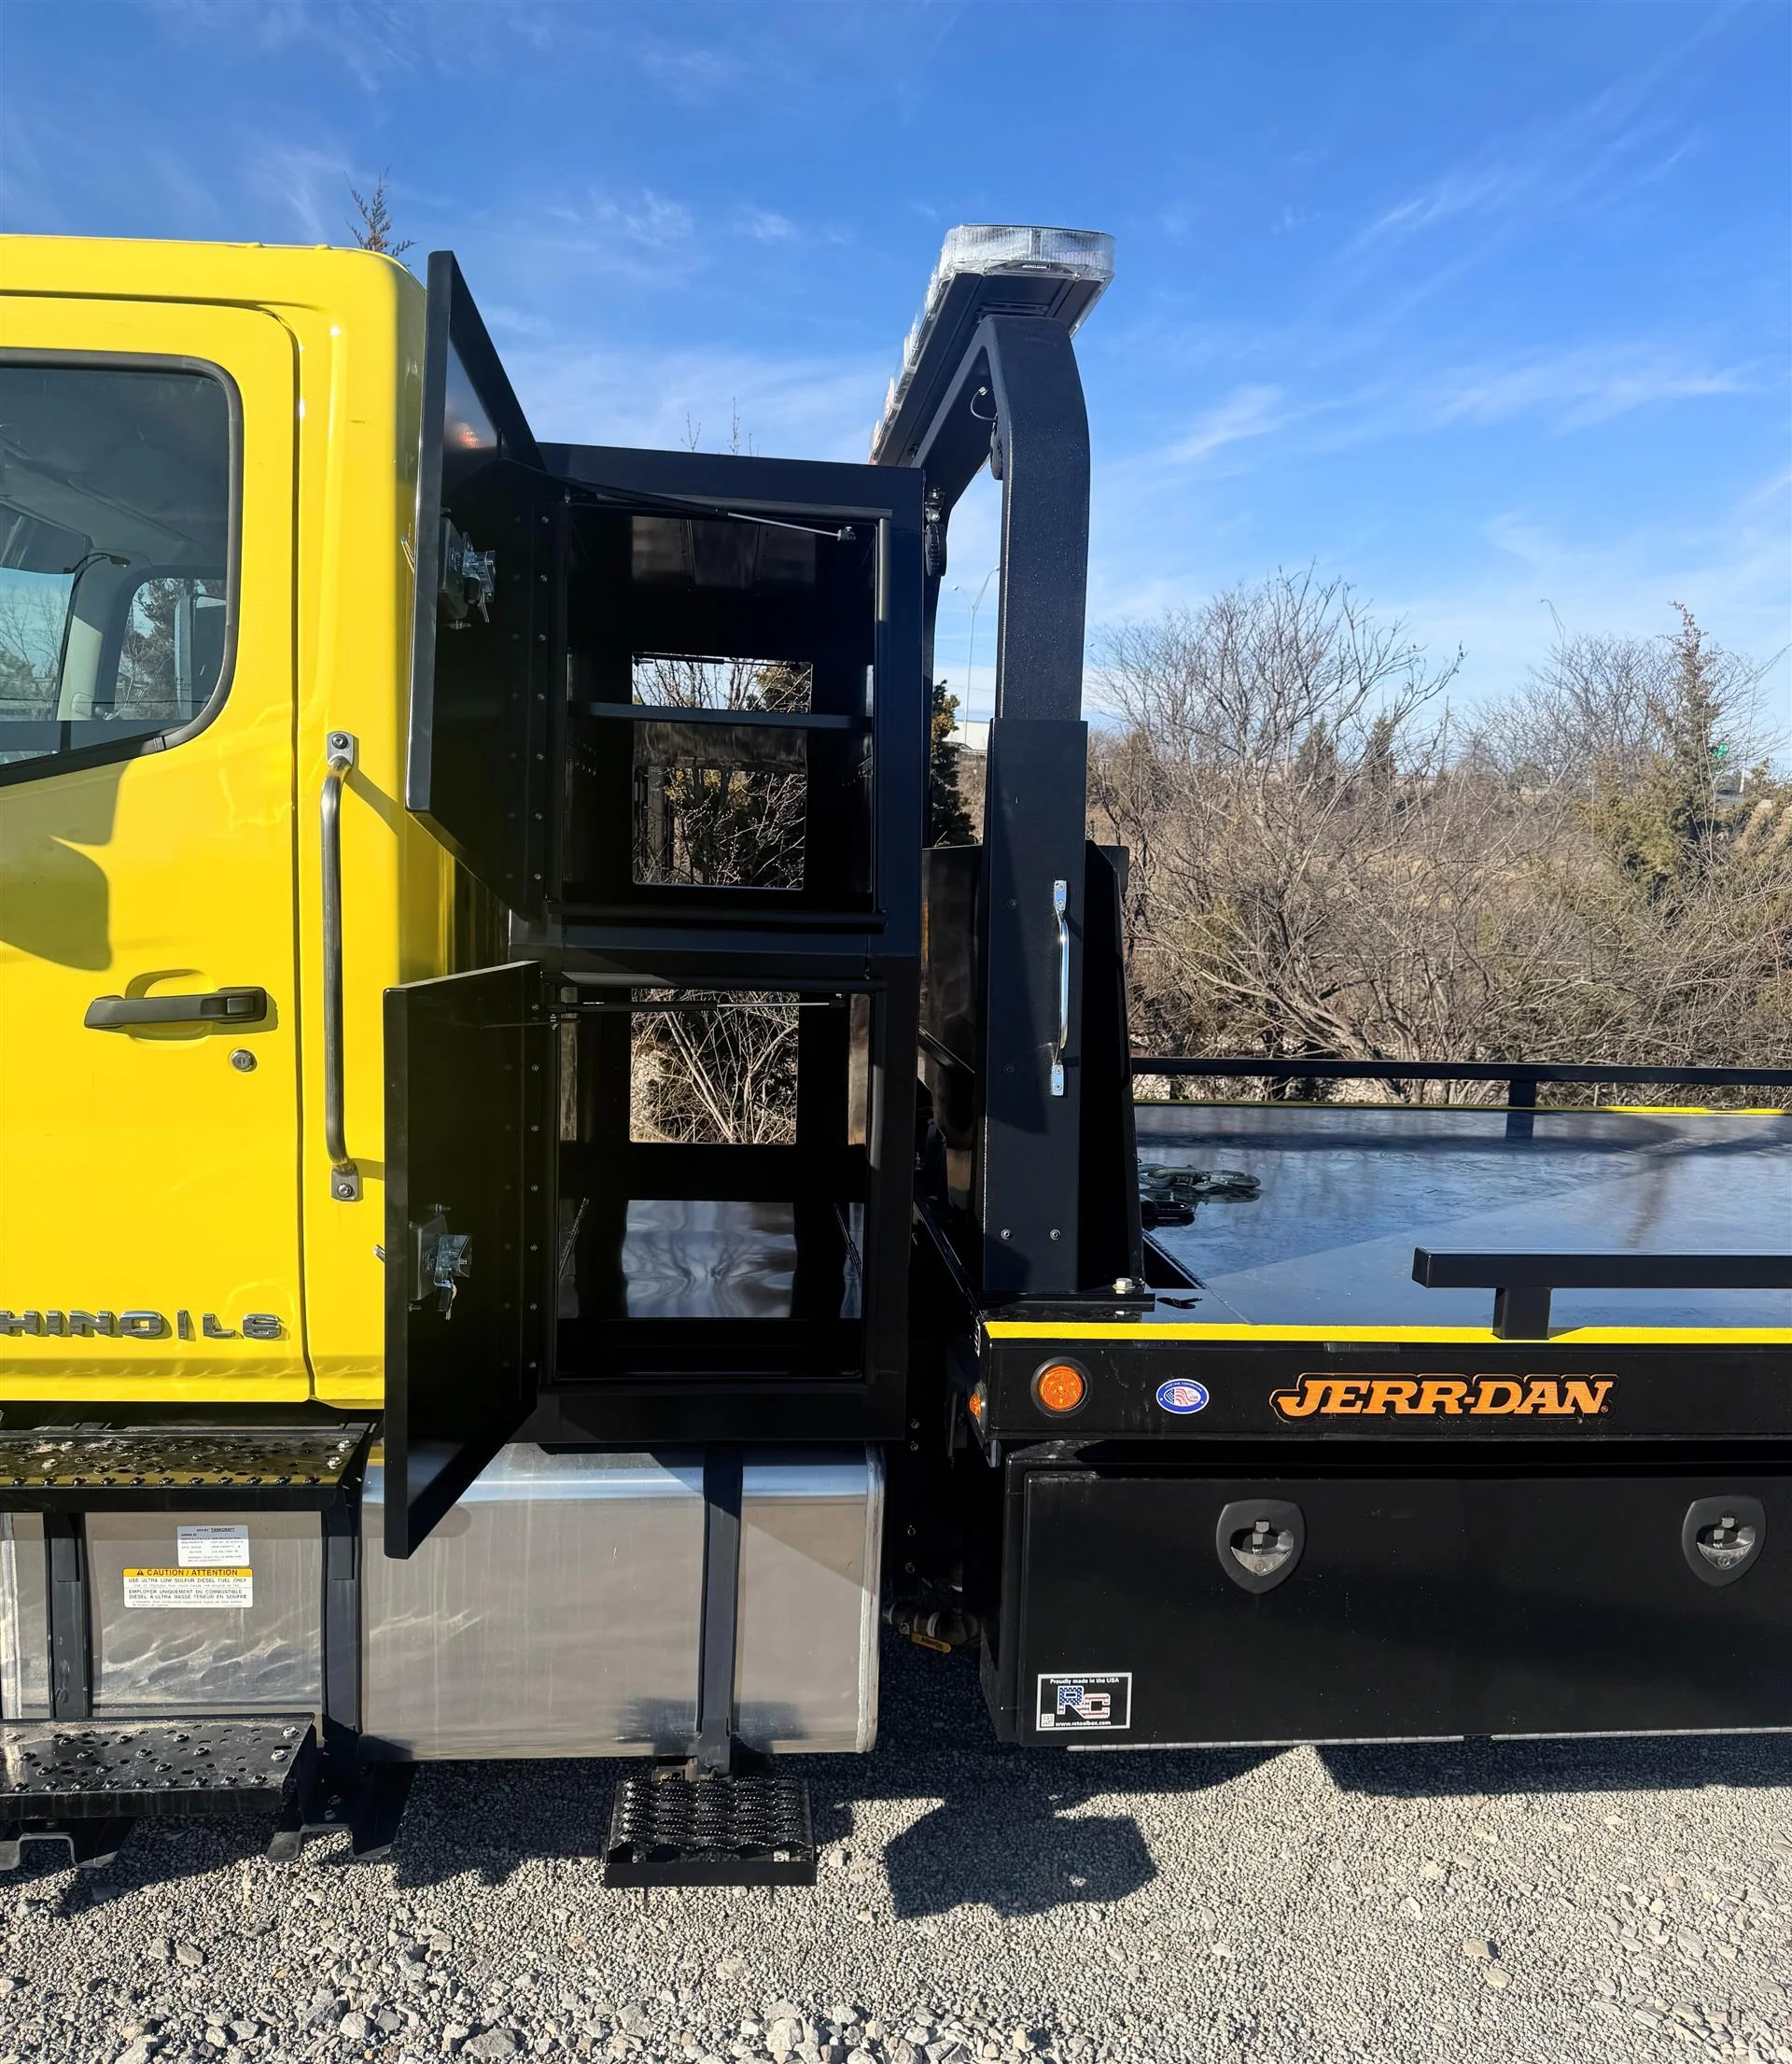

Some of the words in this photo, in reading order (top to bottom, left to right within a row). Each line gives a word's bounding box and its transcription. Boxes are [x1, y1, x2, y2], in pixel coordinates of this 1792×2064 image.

[0, 1310, 164, 1338] HINO
[202, 1313, 283, 1341] L6
[1277, 1380, 1614, 1417] JERR-DAN
[1057, 1685, 1111, 1720] RC
